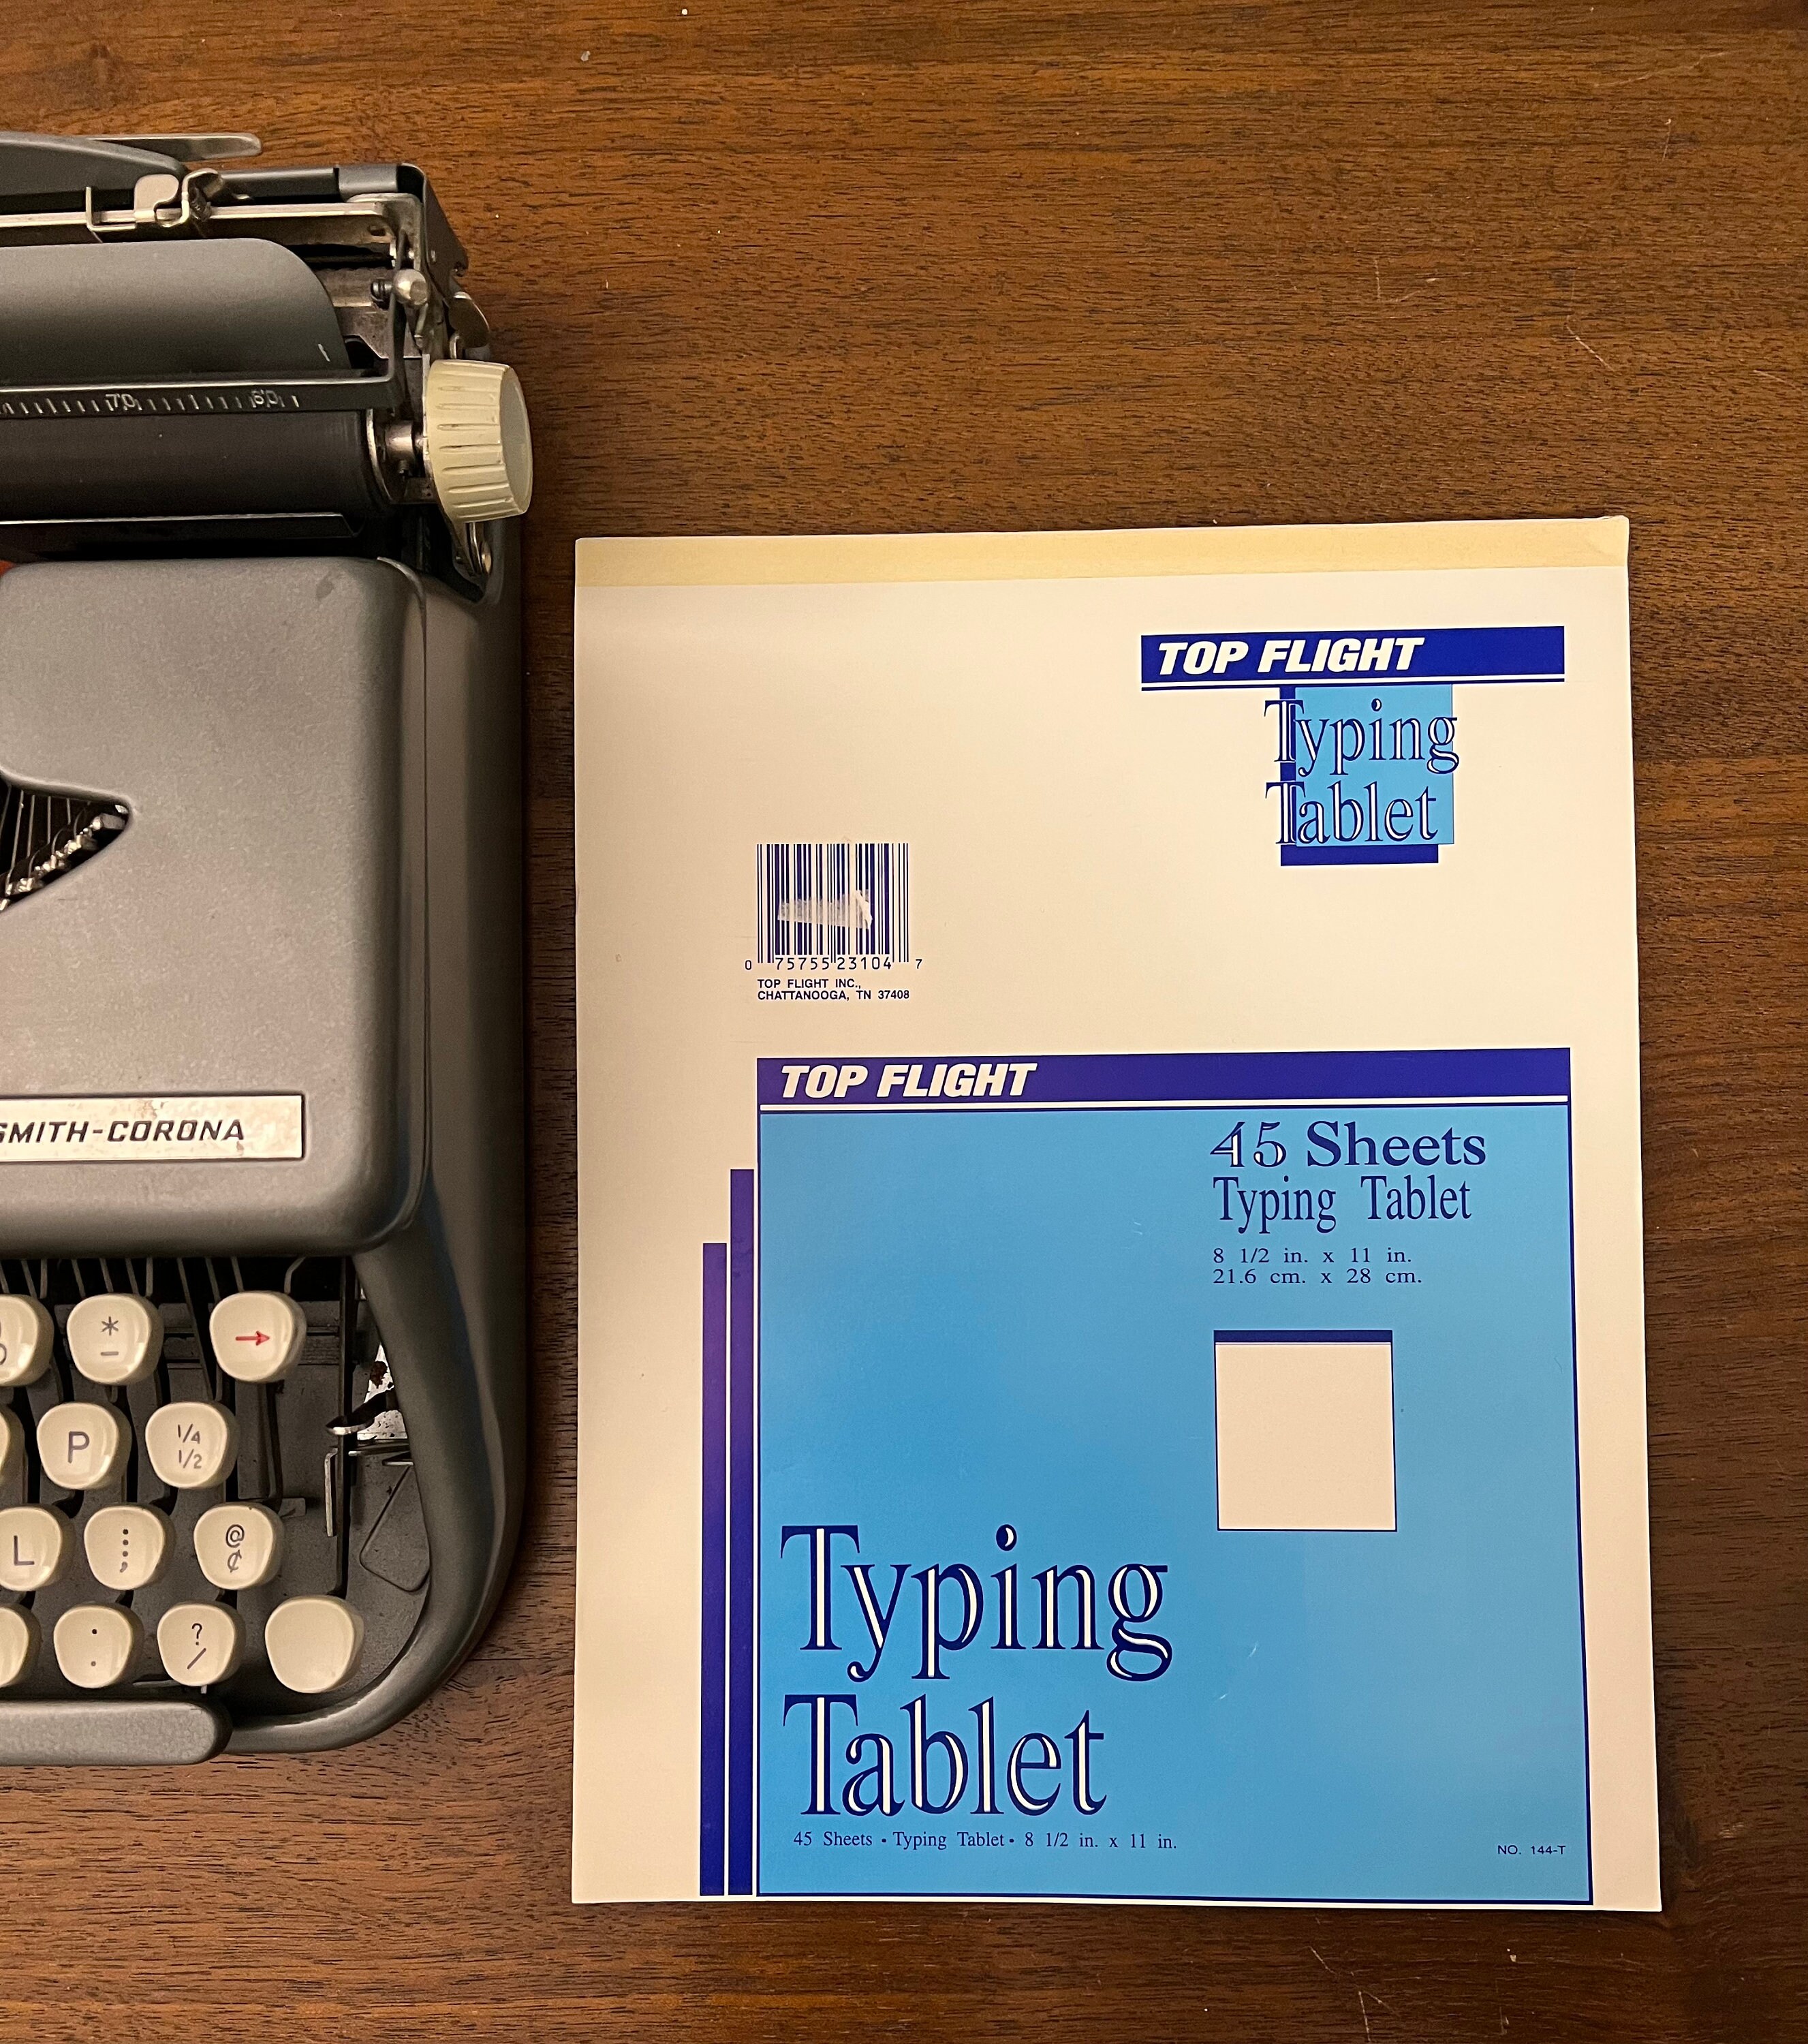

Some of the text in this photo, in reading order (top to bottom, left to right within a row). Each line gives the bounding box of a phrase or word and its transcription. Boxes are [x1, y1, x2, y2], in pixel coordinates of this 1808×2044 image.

[1158, 637, 1425, 675] TOP FLIGHT
[1264, 698, 1459, 777] Typing
[1265, 779, 1439, 845] Tablet
[745, 956, 922, 971] 0 75755 23104 7
[757, 978, 861, 989] TOP FLIGHT INC.,
[758, 989, 909, 1002] CHATTANOOGA, TN 37408
[781, 1062, 1038, 1098] TOP FLIGHT
[1209, 1120, 1486, 1168] 45 Sheets
[1213, 1174, 1472, 1235] Typing Tablet
[1213, 1247, 1412, 1263] 8 1/2 in. x 11 in.
[1213, 1267, 1422, 1284] 21.6 cm. x 28 cm.
[177, 1423, 200, 1444] 1/4
[67, 1431, 90, 1464] P
[178, 1451, 202, 1469] 1/2
[225, 1524, 245, 1548] @
[13, 1534, 35, 1566] L
[780, 1523, 1173, 1683] Typing
[191, 1622, 203, 1646] ?
[782, 1693, 1108, 1817] Tablet
[793, 1831, 812, 1846] 45
[823, 1831, 873, 1846] Sheets
[892, 1831, 947, 1851] Typing
[956, 1831, 1005, 1846] Tablet
[1025, 1831, 1033, 1847] 8
[1046, 1831, 1069, 1847] 1/2
[1079, 1832, 1098, 1848] in.
[1109, 1837, 1119, 1848] x
[1131, 1833, 1146, 1848] 11
[1157, 1833, 1176, 1849] in.
[1497, 1844, 1566, 1855] NO. 144-T
